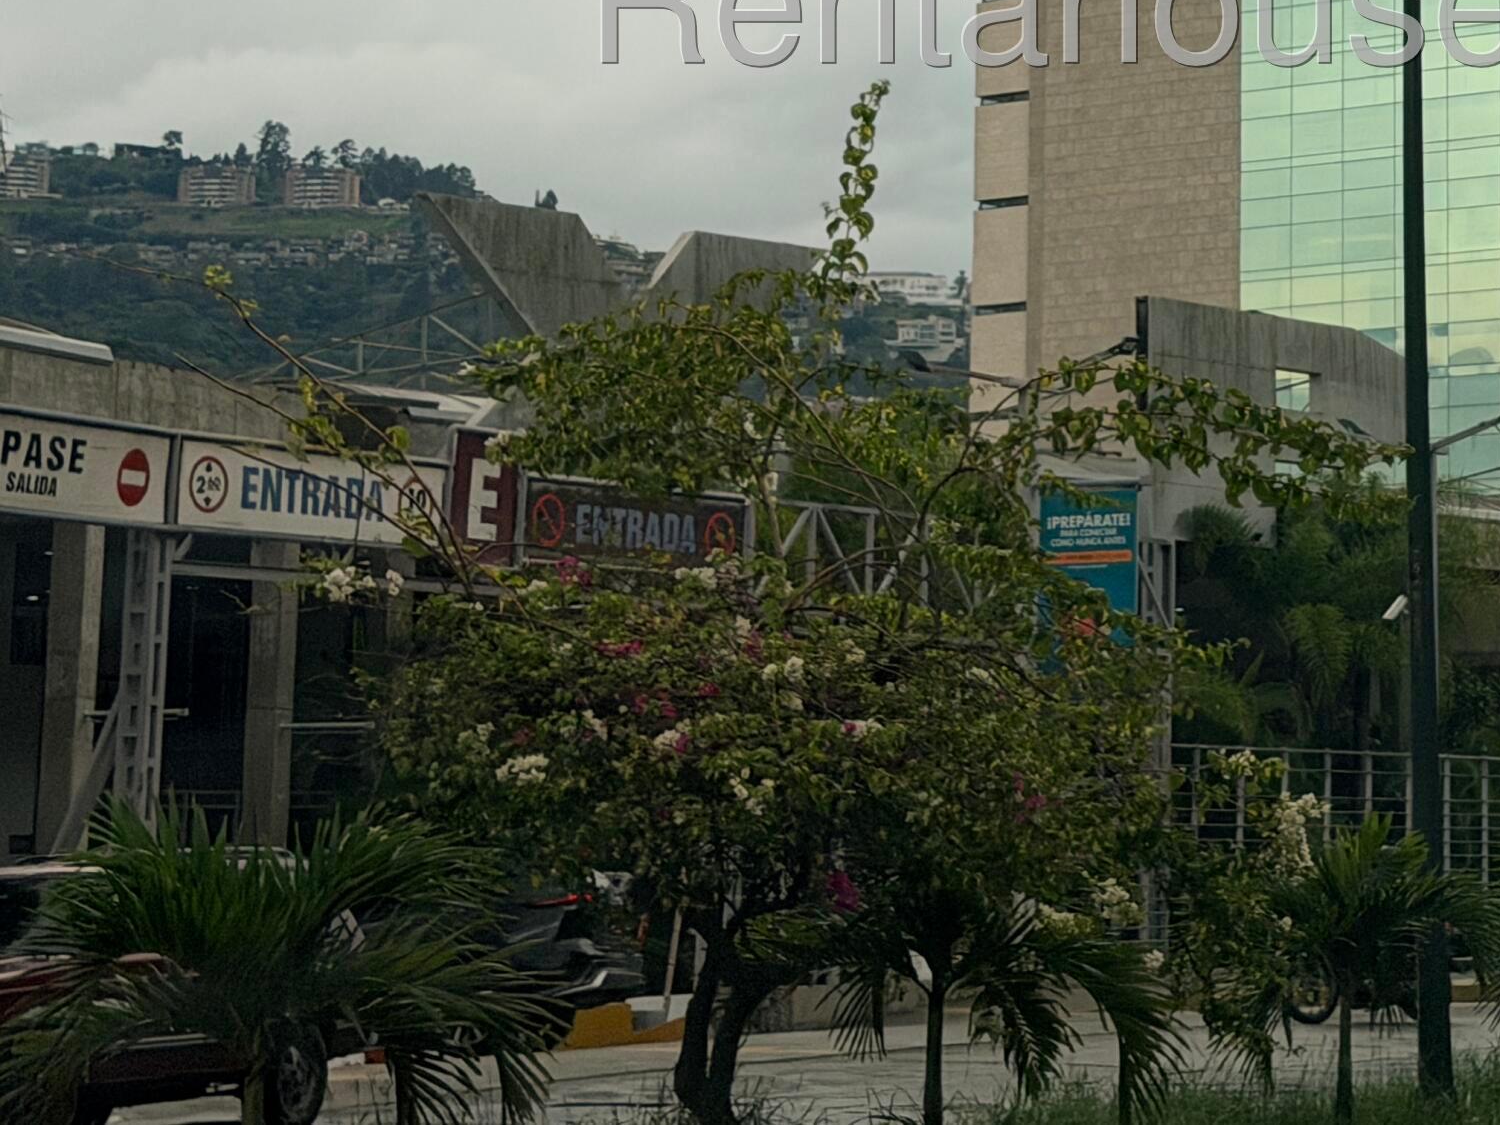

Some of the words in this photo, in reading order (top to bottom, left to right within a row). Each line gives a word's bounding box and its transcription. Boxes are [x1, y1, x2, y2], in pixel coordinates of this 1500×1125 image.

[1, 430, 87, 474] PASE
[6, 472, 57, 497] SALIDA
[240, 466, 384, 522] ENTRADA
[467, 458, 501, 541] E
[575, 504, 696, 554] ENTRADA
[1047, 511, 1131, 529] ¡PREPÁRATE!
